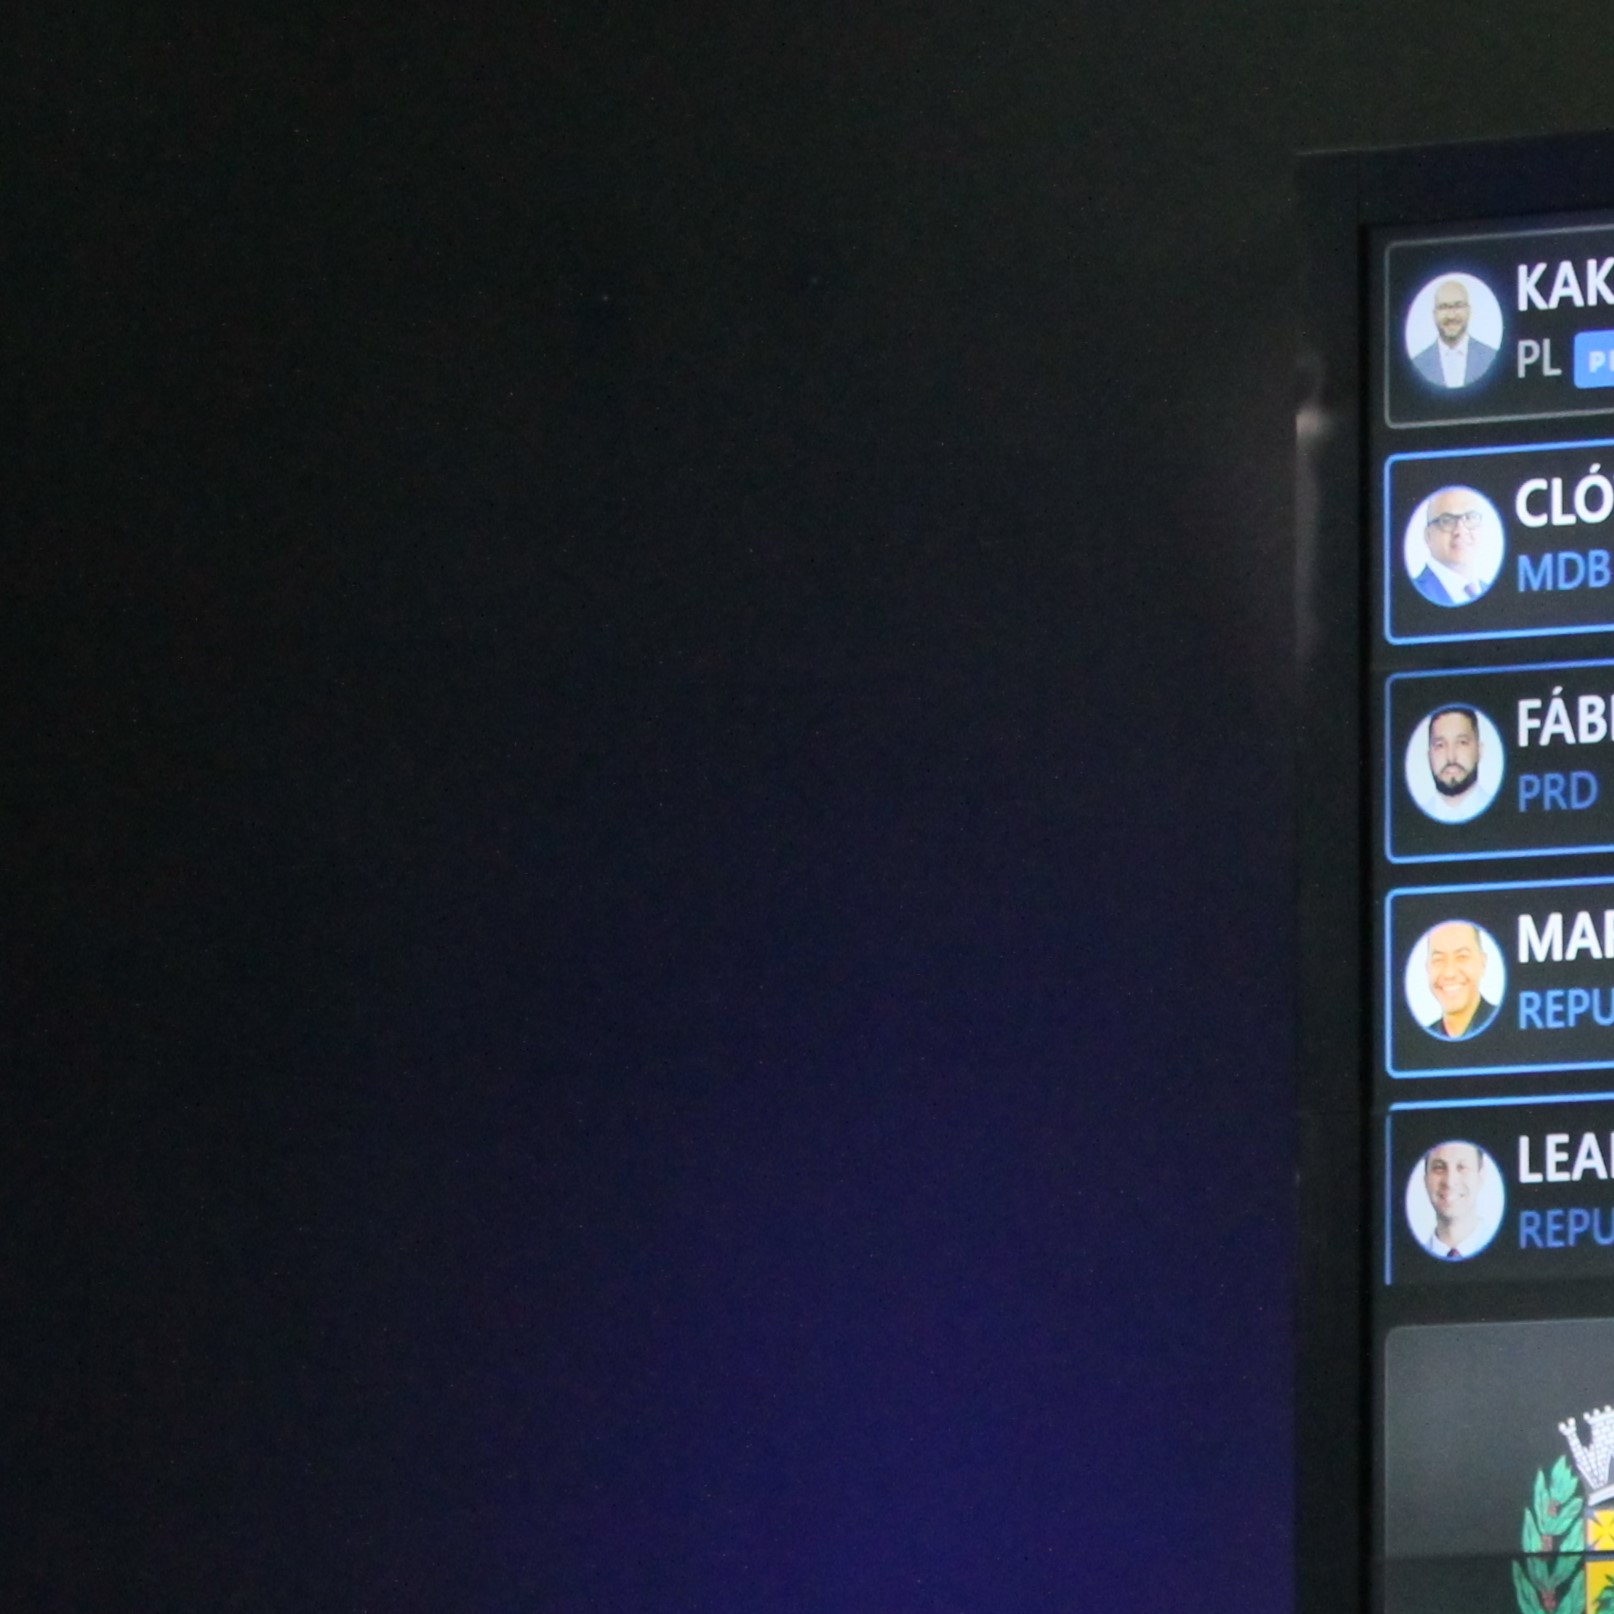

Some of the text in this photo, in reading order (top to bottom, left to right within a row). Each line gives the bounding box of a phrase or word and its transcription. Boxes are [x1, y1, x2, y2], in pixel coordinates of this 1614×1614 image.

[1518, 339, 1562, 378] PL
[1518, 550, 1611, 592] MDB
[1519, 772, 1597, 811] PRD
